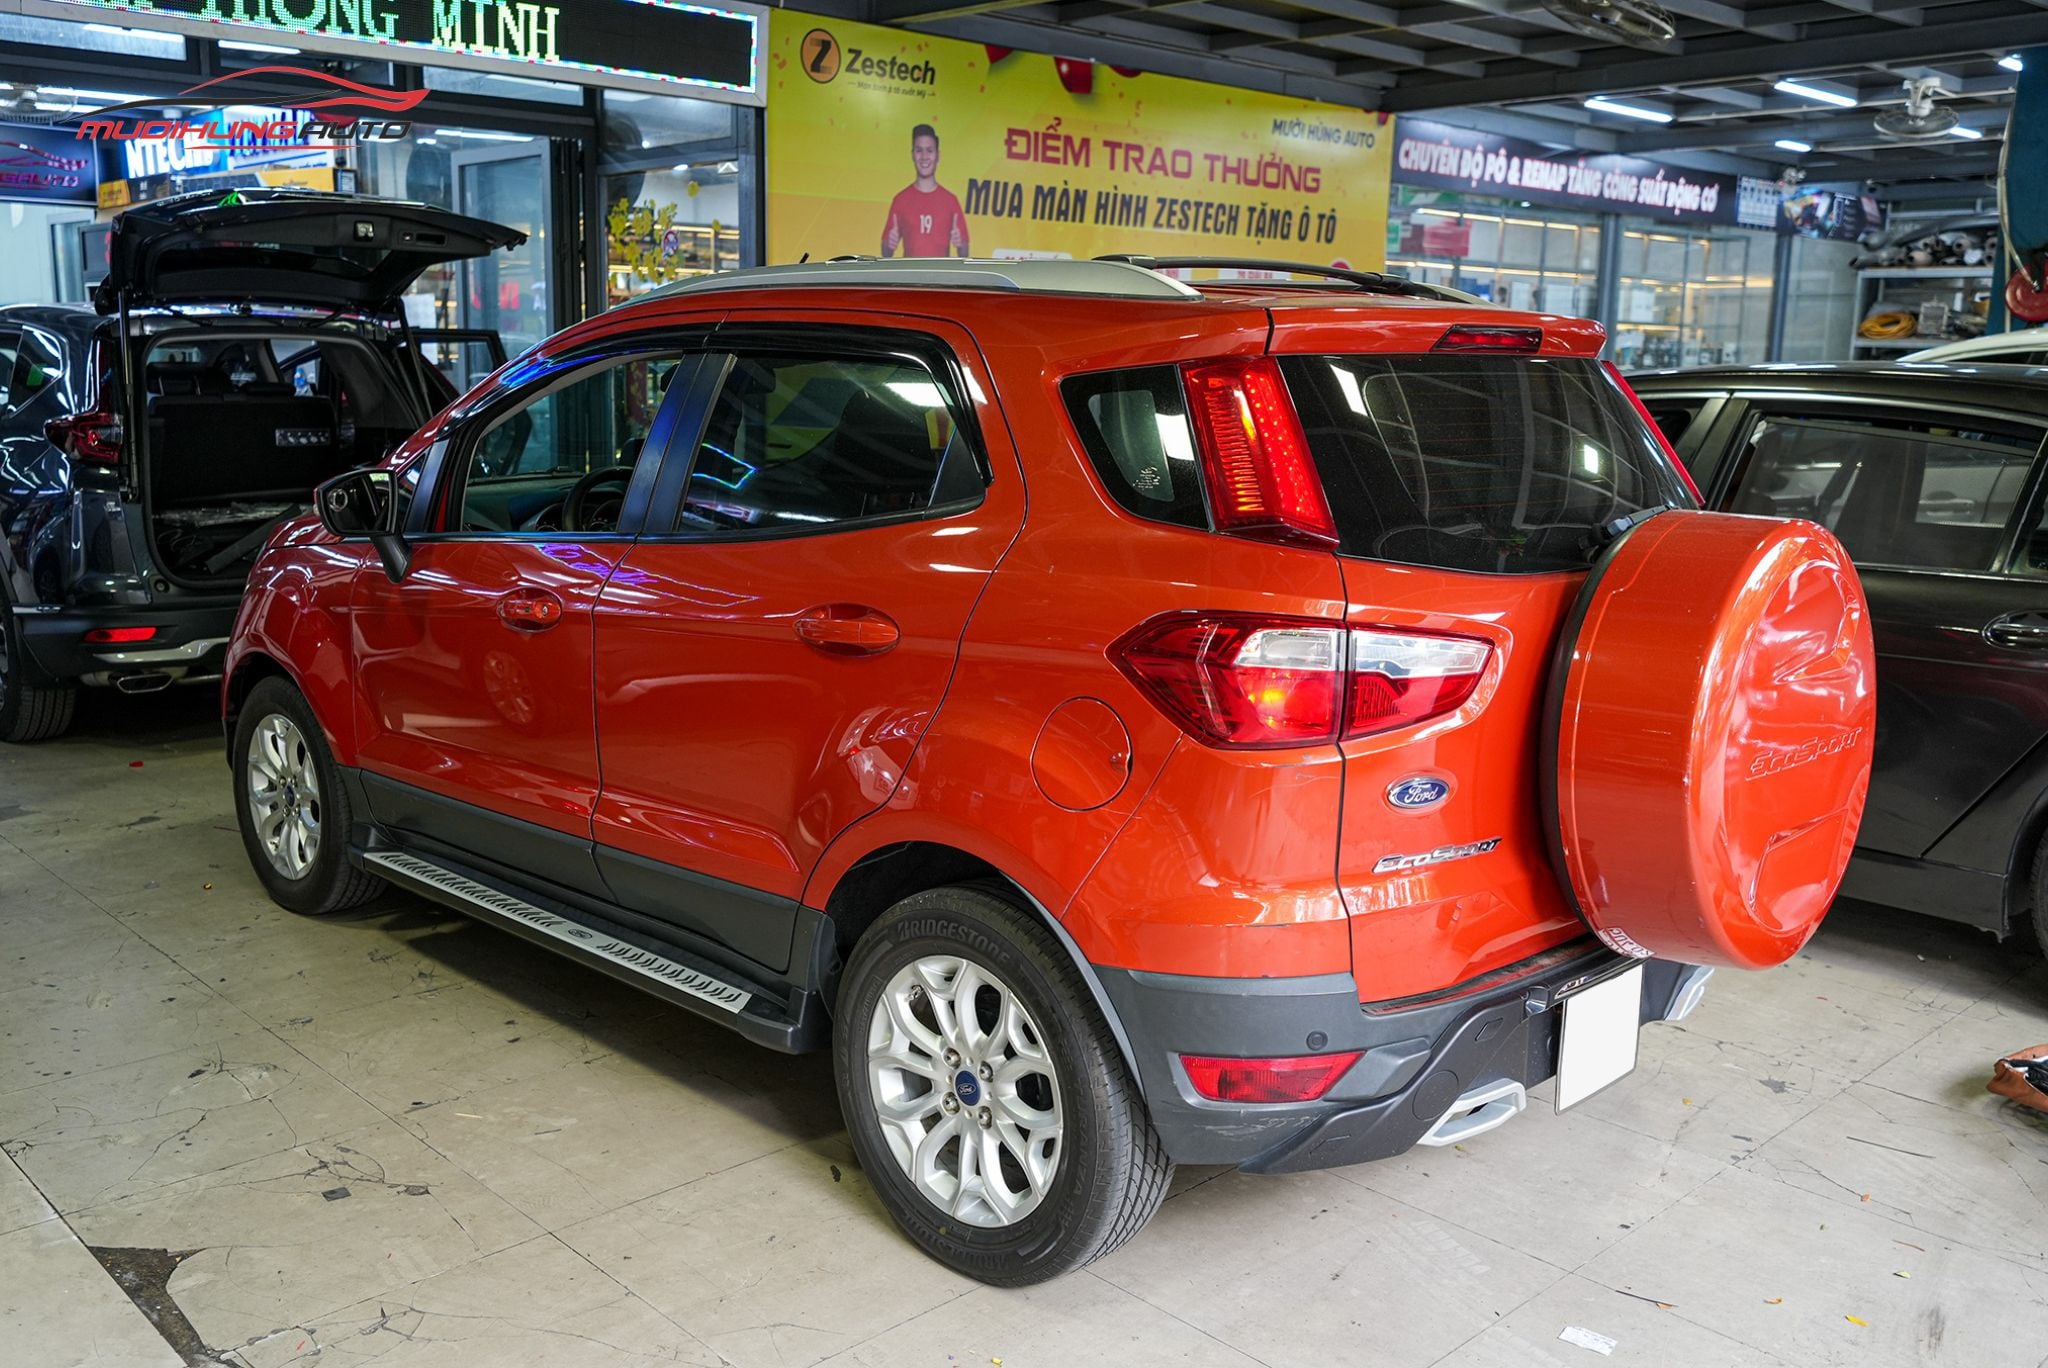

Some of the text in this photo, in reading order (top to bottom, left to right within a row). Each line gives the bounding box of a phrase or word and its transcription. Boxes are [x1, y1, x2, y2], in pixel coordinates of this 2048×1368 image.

[432, 0, 560, 63] MINH
[845, 47, 937, 86] Zestech
[1004, 116, 1321, 194] ĐIỂM TRAO THƯỞNG
[1272, 117, 1376, 149] MƯỜI HÙNG AUTO
[1398, 138, 1461, 177] CHUYÊN
[1483, 146, 1509, 184] PÔ
[1507, 156, 1521, 186] &
[1521, 158, 1569, 192] REMAP
[919, 214, 933, 235] 19
[964, 177, 1338, 246] MUA MÀN HÌNH ZESTECH TẶNG Ô TÔ
[1403, 783, 1440, 804] Ford
